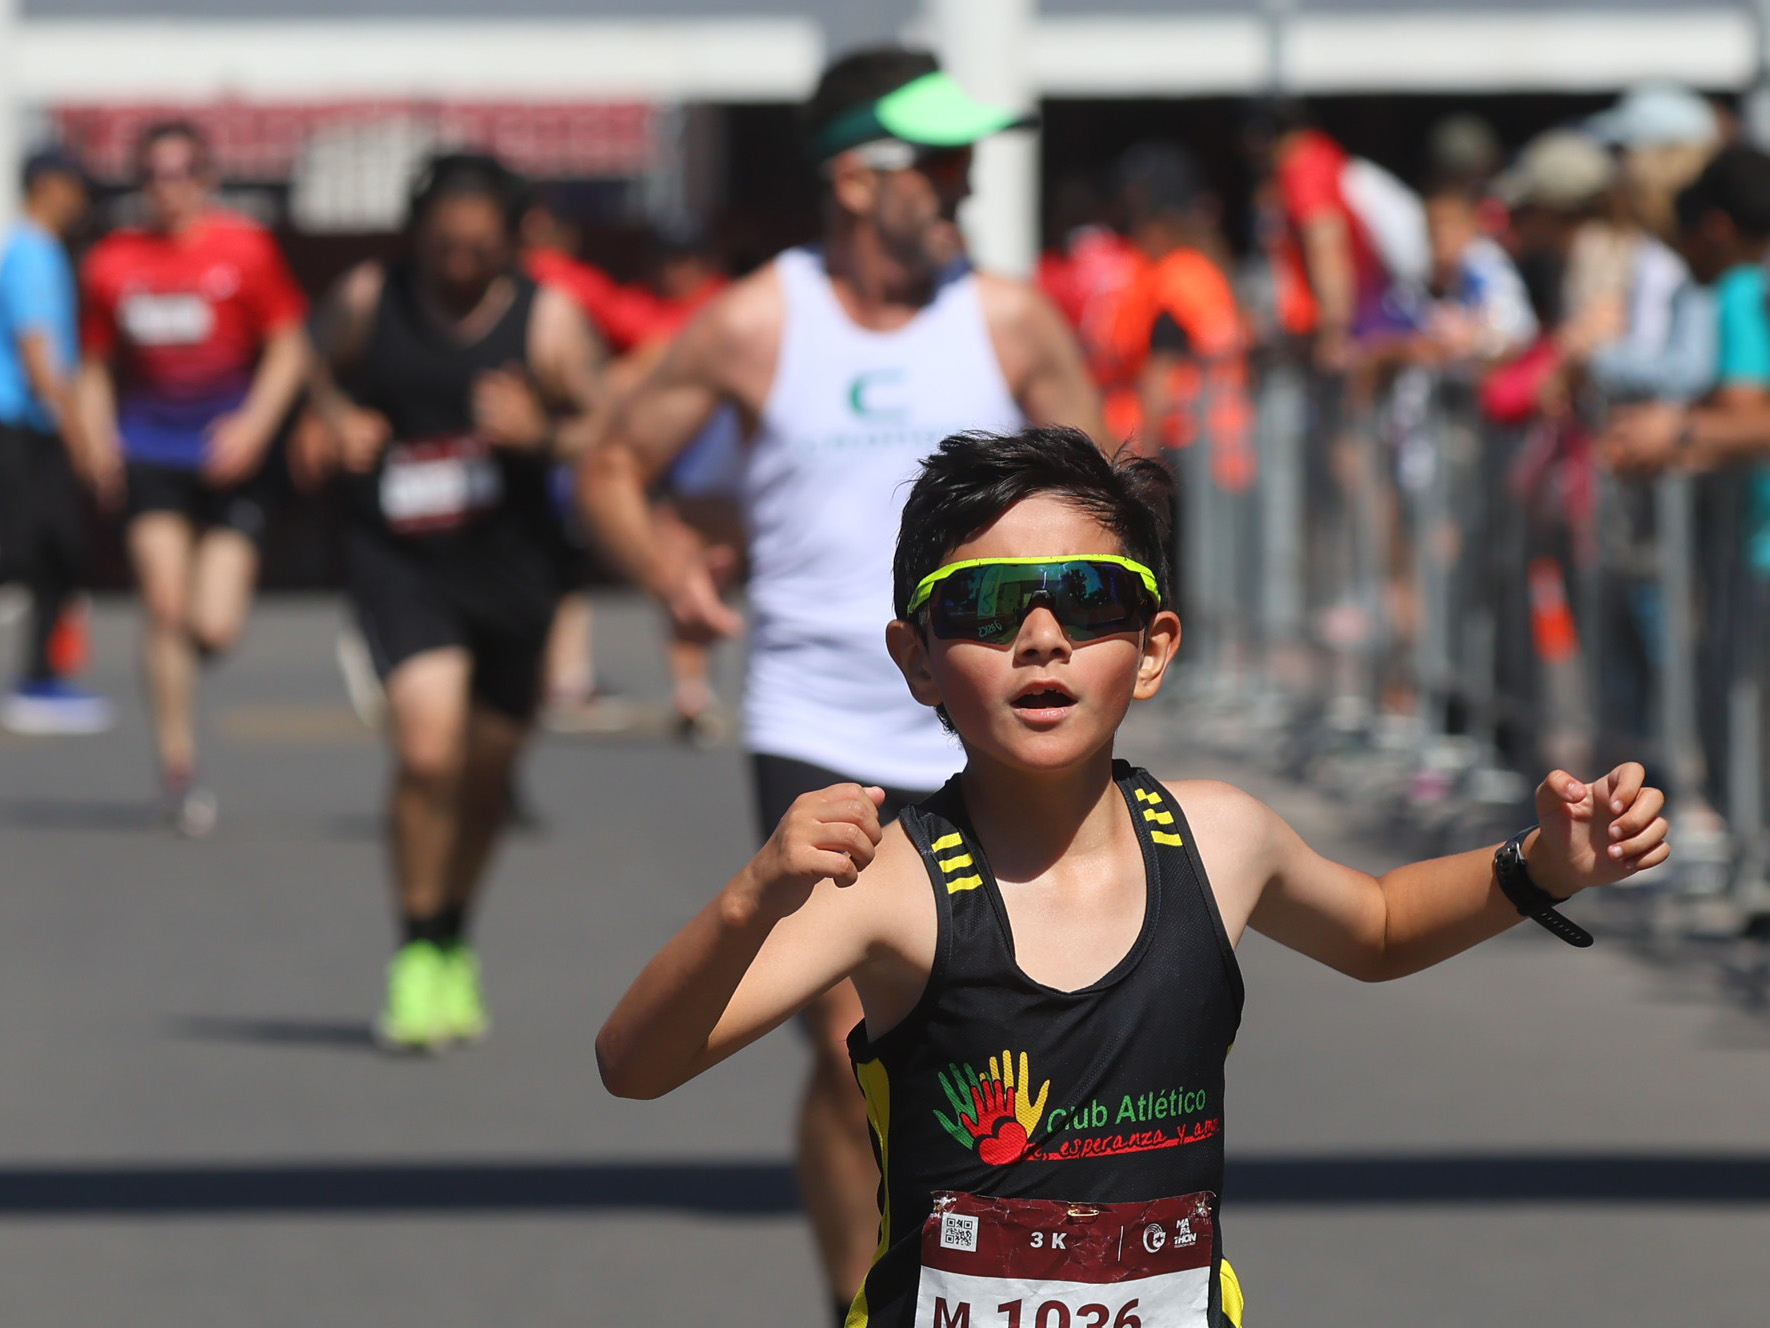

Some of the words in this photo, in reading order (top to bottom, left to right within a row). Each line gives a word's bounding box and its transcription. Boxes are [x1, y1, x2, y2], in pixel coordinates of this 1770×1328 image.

[1115, 1087, 1206, 1127] Atlético
[1060, 1129, 1166, 1158] esperanza
[1030, 1231, 1043, 1249] 3
[1052, 1232, 1068, 1249] K
